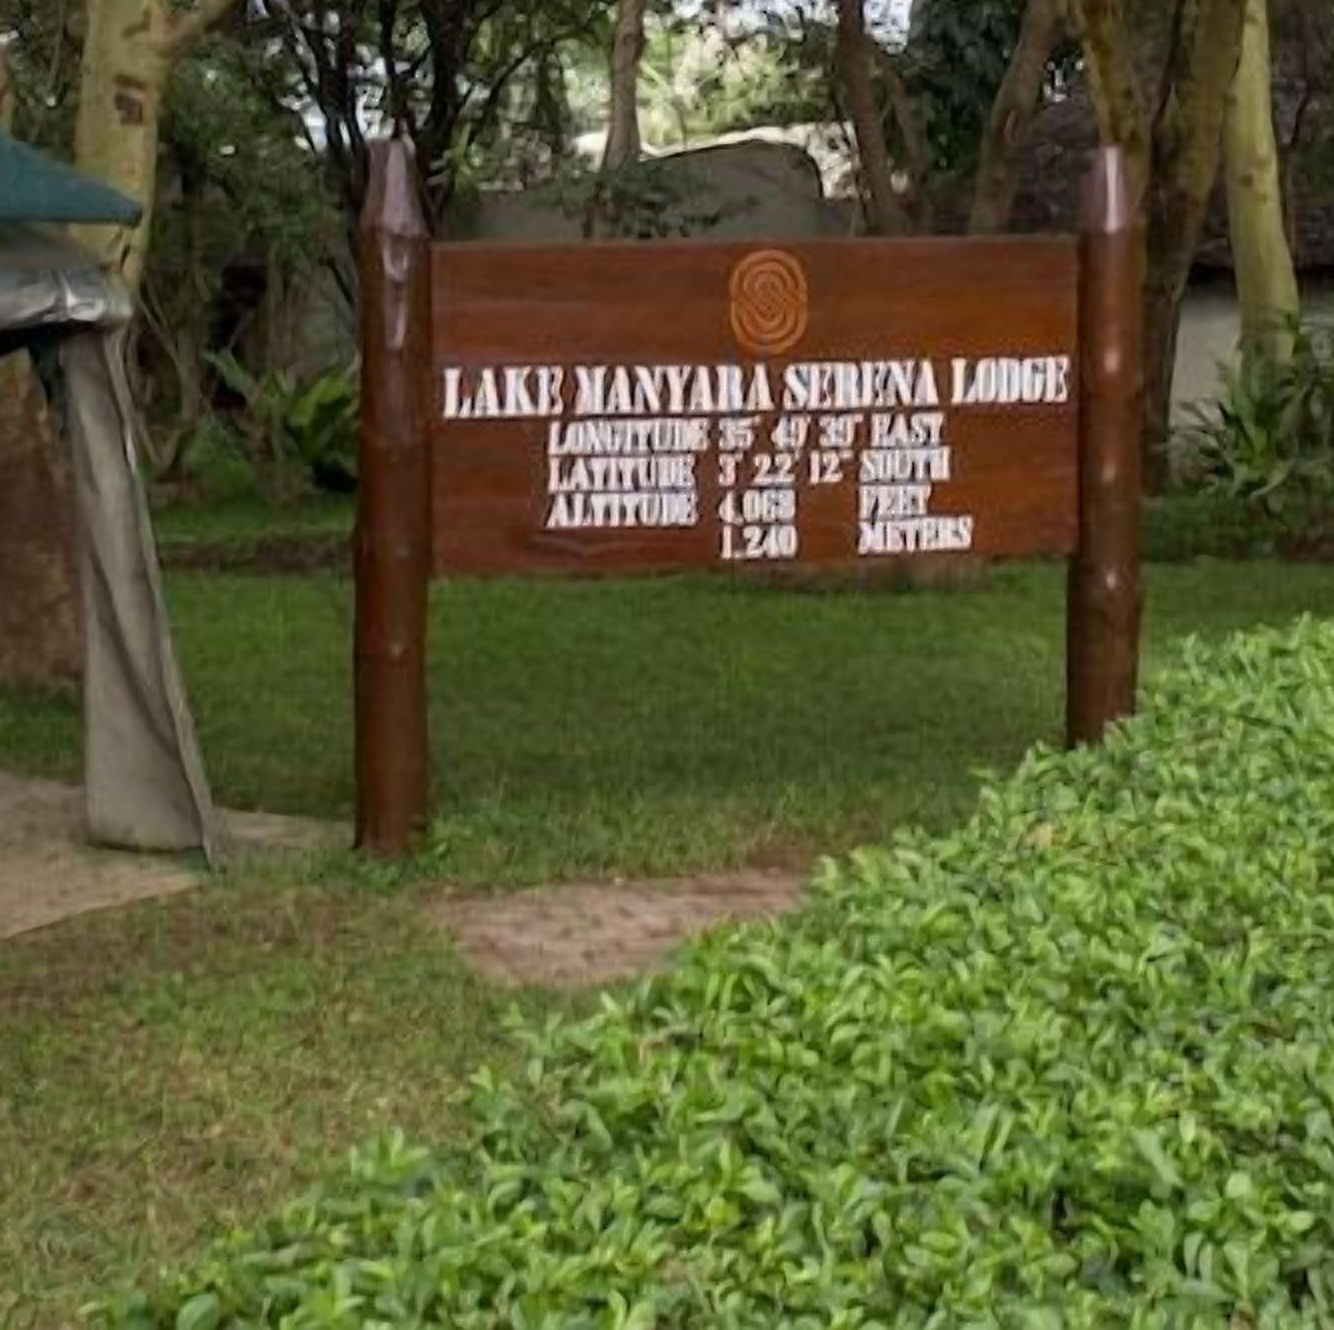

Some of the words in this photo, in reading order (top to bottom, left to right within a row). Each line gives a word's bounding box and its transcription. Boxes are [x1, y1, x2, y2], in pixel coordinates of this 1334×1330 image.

[443, 365, 564, 418] LAKE
[573, 361, 775, 415] MANYARA
[782, 358, 940, 411] SERENA
[951, 356, 1069, 405] LODGE
[548, 418, 709, 455] LONGITUDE
[870, 412, 945, 447] EAST
[548, 453, 696, 493] LATITUDE
[859, 445, 951, 482] SOUTH
[546, 491, 698, 528] ALTITUDE
[858, 484, 932, 520] FEET
[858, 515, 974, 556] METERS
